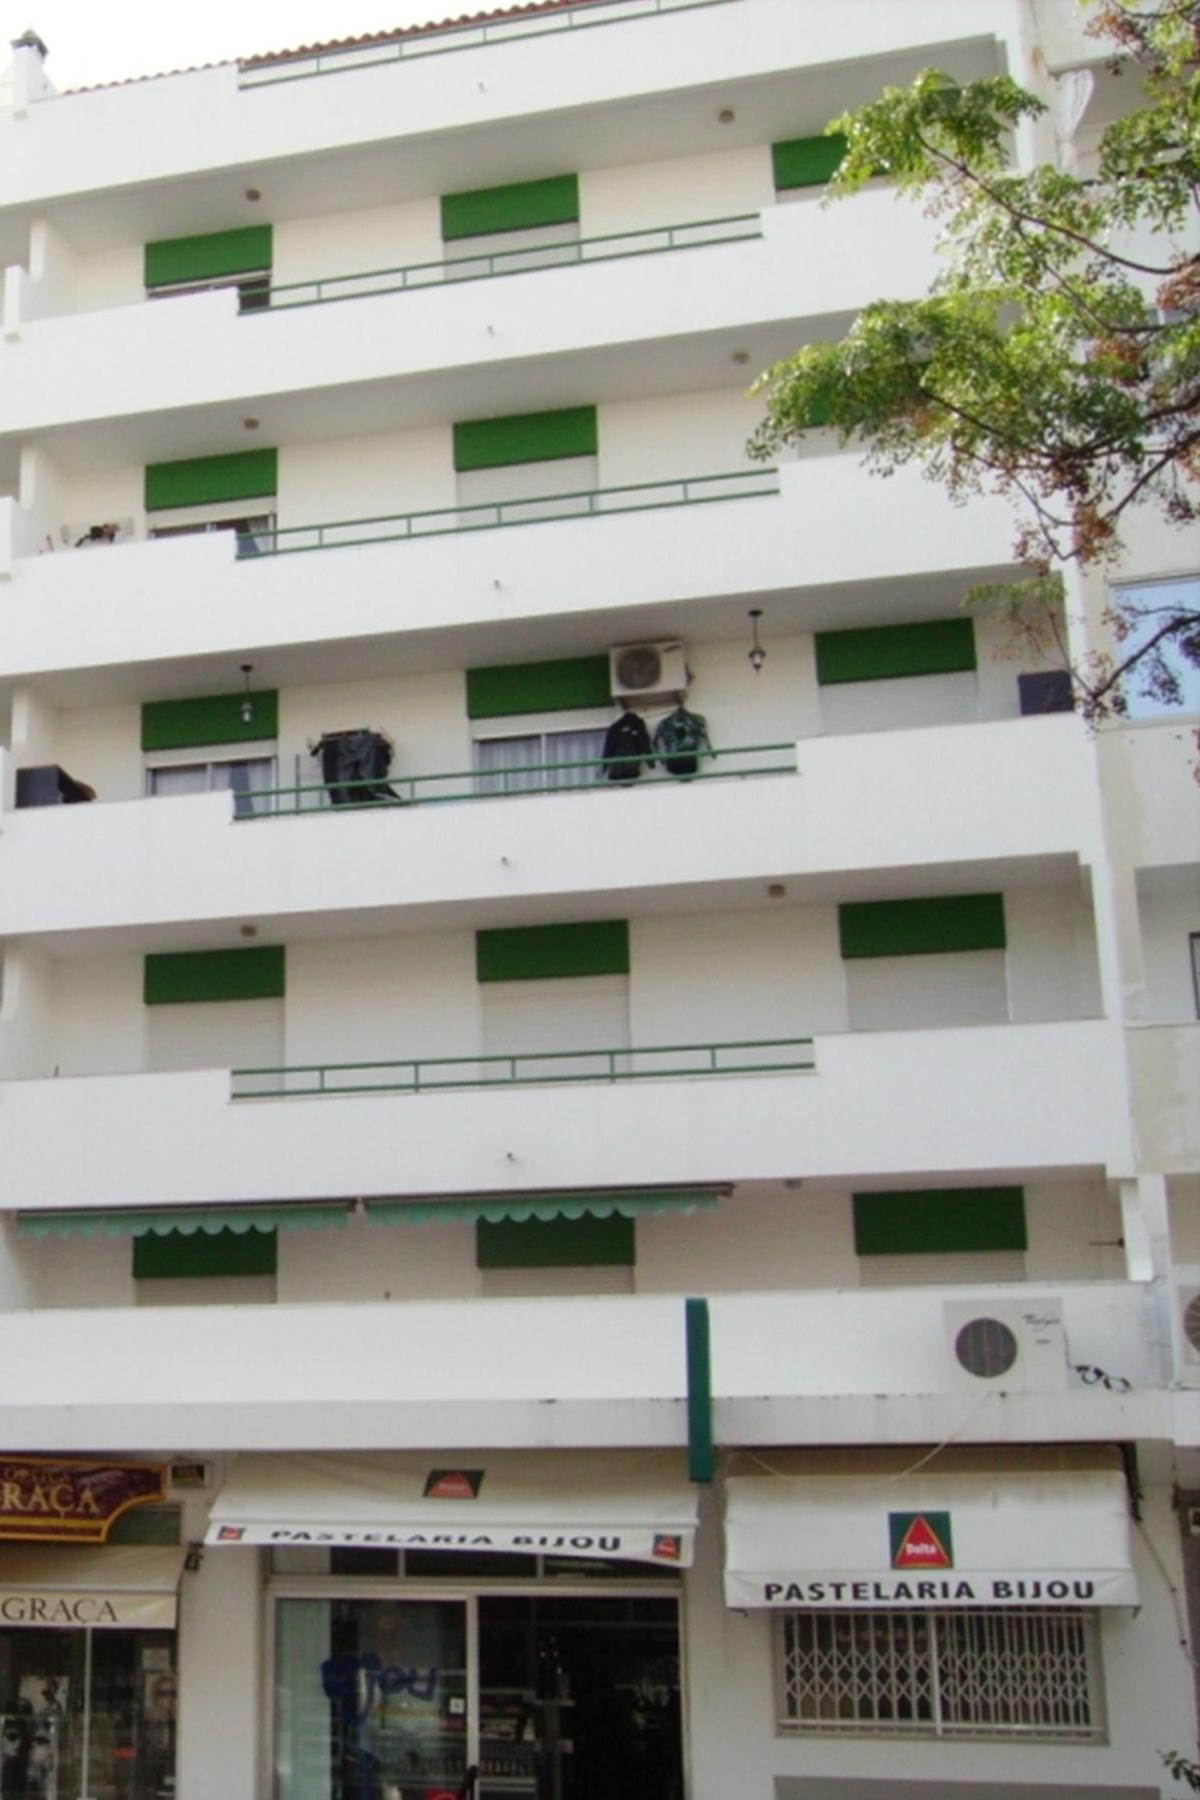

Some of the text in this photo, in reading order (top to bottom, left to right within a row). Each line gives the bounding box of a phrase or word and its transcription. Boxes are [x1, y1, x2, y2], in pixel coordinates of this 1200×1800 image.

[270, 1530, 622, 1552] PASTELARIA BIJOU
[764, 1579, 1095, 1601] PASTELARIA BIJOU
[0, 1596, 119, 1624] GRAÇA
